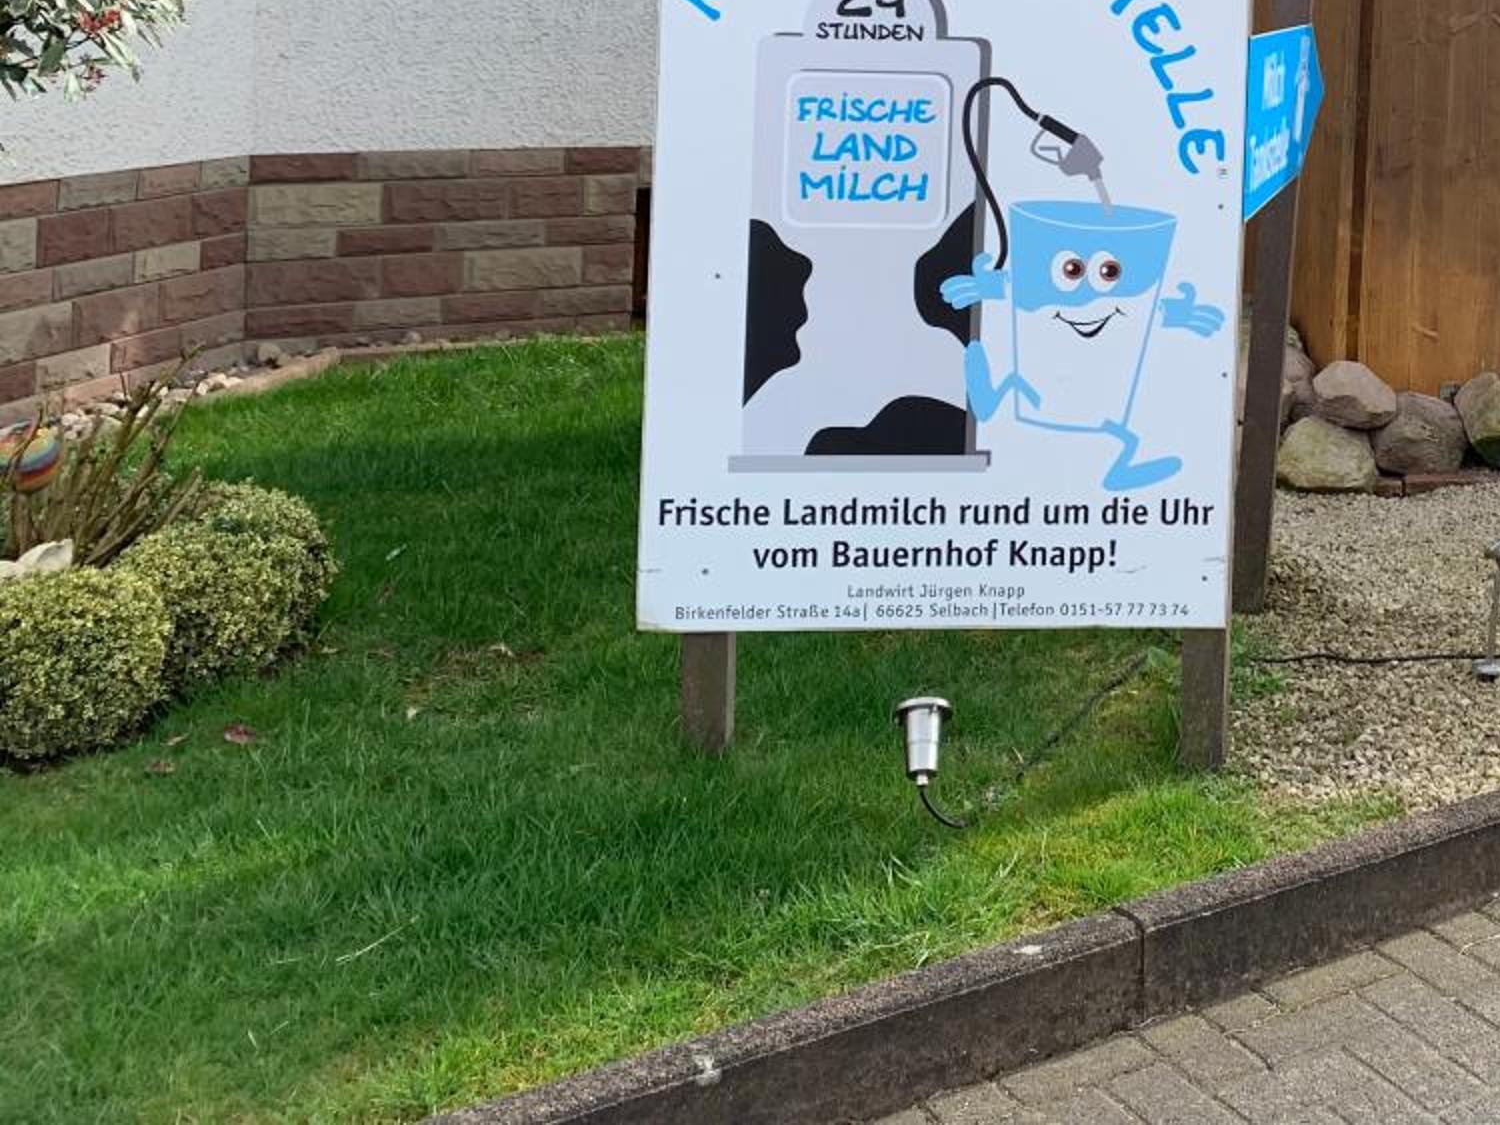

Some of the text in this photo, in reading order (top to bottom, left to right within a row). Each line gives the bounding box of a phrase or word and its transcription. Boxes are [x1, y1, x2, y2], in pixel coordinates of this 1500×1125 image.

[815, 22, 924, 41] STUNDEN
[796, 96, 936, 124] FRISCHE
[811, 132, 918, 164] LAND
[799, 171, 929, 203] MILCH
[659, 496, 1215, 526] Frische Landmilch rund um die Uhr
[753, 539, 1117, 573] vom Bauernhof Knapp!
[847, 583, 1025, 602] Landwirt Jürgen Knapp
[675, 604, 771, 620] Birkenfelder
[777, 604, 829, 619] Straße
[875, 604, 923, 618] 66625
